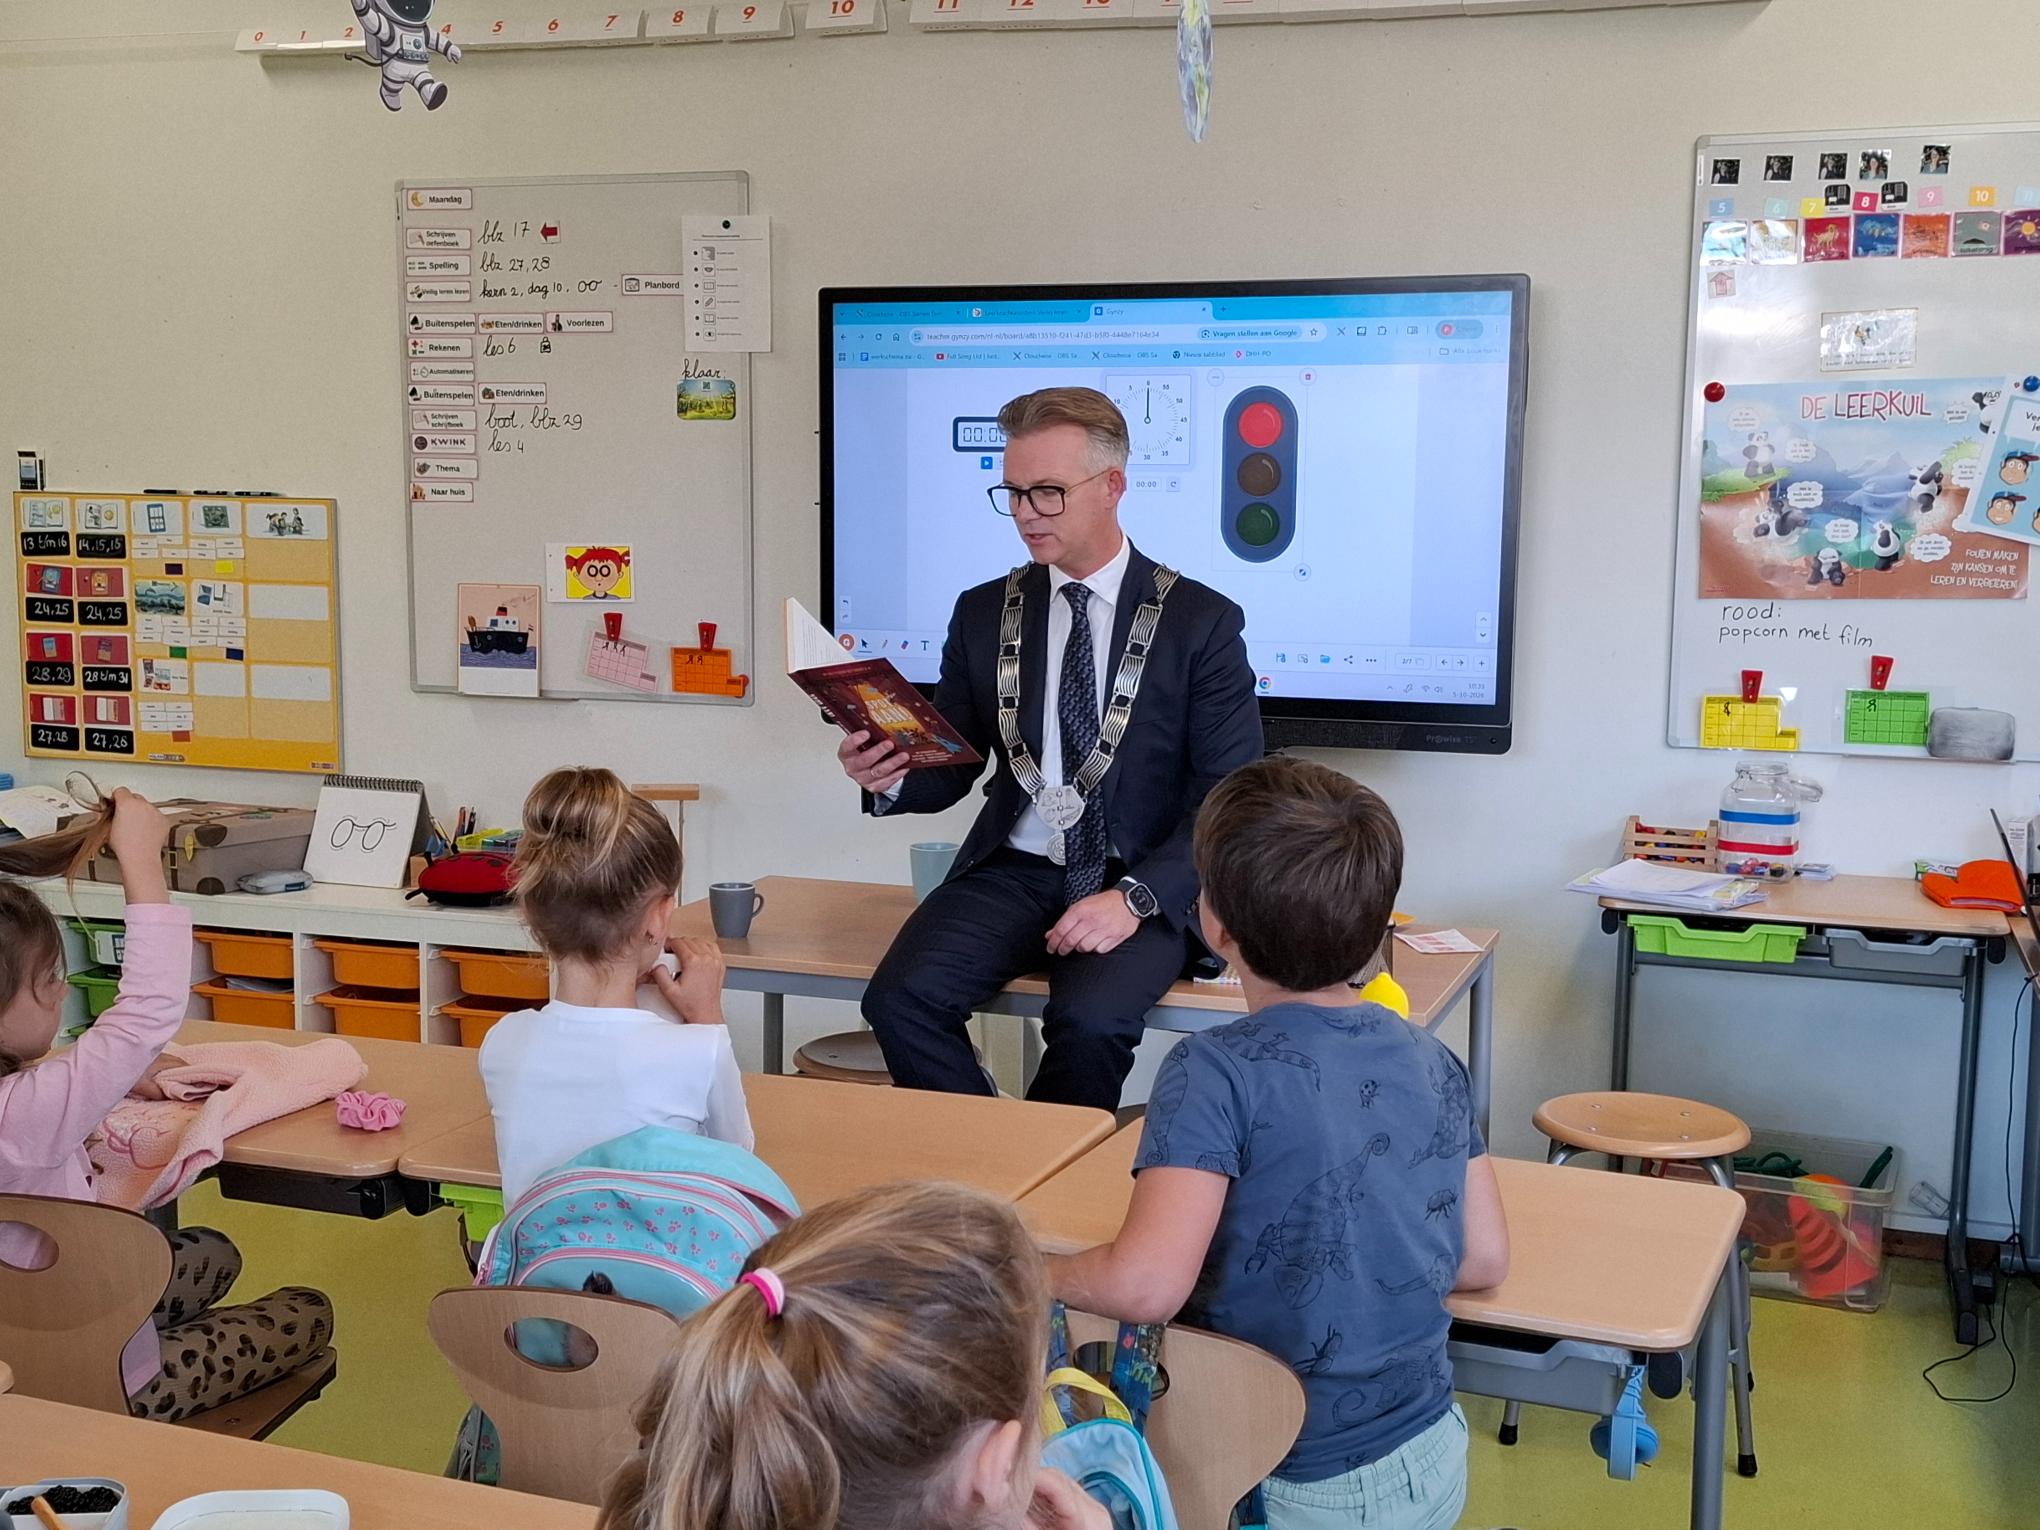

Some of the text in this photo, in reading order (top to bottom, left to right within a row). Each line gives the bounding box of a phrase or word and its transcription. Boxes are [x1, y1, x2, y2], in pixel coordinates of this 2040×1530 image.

[254, 31, 263, 41] 0
[300, 30, 306, 40] 1
[344, 27, 353, 38] 2
[441, 24, 451, 34] 4
[492, 21, 503, 32] 5
[548, 19, 558, 31] 6
[606, 15, 617, 27] 7
[672, 10, 684, 23] 8
[743, 6, 755, 20] 9
[832, 0, 854, 14] 10
[428, 196, 463, 205] Maandag
[1718, 203, 1726, 212] 5
[1809, 203, 1816, 213] 7
[1861, 196, 1870, 208] 8
[1926, 191, 1934, 202] 9
[1975, 190, 1989, 202] 10
[477, 220, 529, 244] blz 17
[429, 262, 460, 271] Spelling
[480, 251, 502, 272] blz
[527, 282, 549, 300] dag
[644, 281, 680, 289] Planbord
[425, 320, 475, 330] Buitenspelen
[495, 320, 542, 328] Eten/drinken
[566, 319, 605, 327] Voorlezen
[1213, 330, 1236, 338] Vragen
[1273, 330, 1297, 338] Google
[429, 344, 461, 352] Rekenen
[483, 335, 516, 356] les 6
[424, 390, 474, 401] Buitenspelen
[495, 389, 544, 397] Eten/drinken
[1801, 396, 1826, 420] DE
[530, 405, 560, 430] blz
[563, 414, 583, 430] 29
[431, 438, 466, 446] KWINK
[488, 429, 524, 453] les 4
[435, 464, 460, 472] Thema
[23, 535, 67, 551] 13 t/m 16
[1992, 549, 2019, 561] MAKEN
[1965, 562, 1993, 574] KANSEN
[1994, 565, 2006, 575] OM
[1930, 575, 1955, 586] LEREN
[1956, 576, 1966, 586] EN
[86, 605, 122, 620] 24,25
[1722, 601, 1781, 621] rood:
[1719, 623, 1873, 647] popcorn met film
[85, 670, 128, 684] 28 t/m 31
